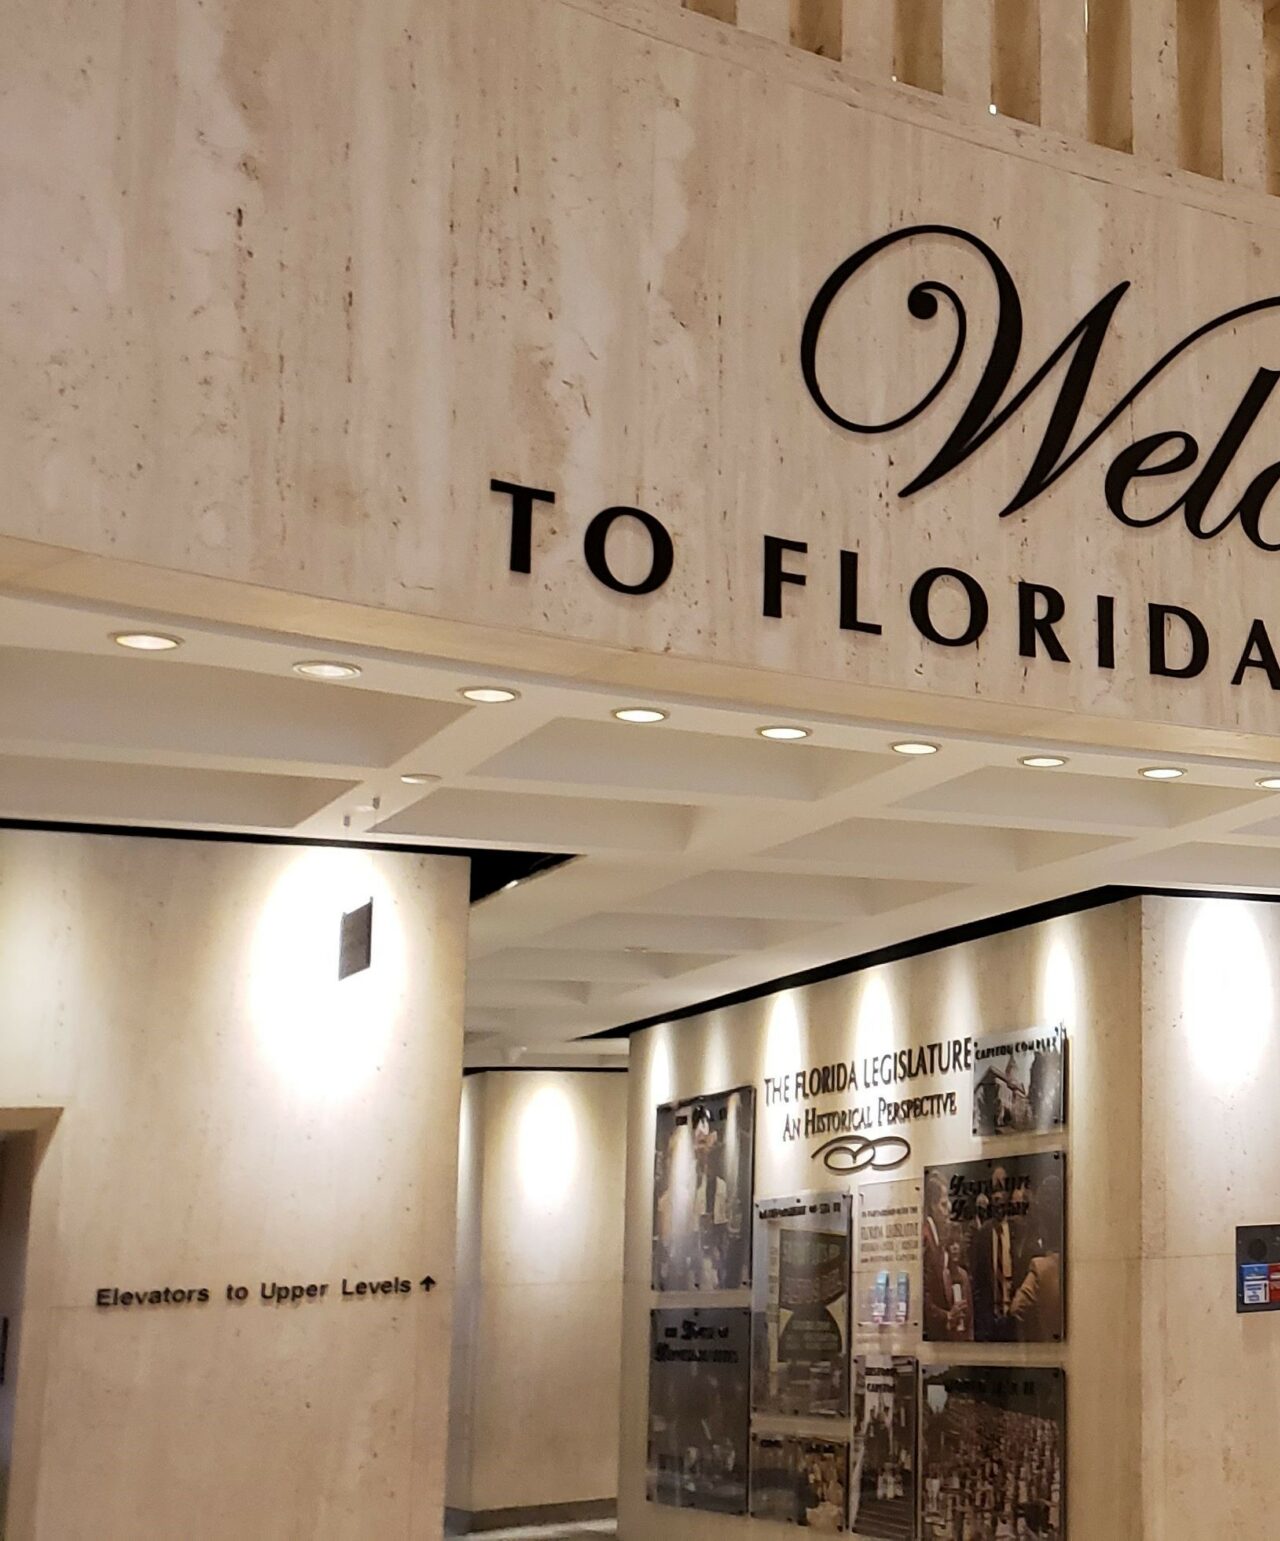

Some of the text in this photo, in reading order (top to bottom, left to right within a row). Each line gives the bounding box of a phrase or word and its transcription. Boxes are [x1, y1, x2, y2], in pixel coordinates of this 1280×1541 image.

[490, 478, 674, 596] TO
[764, 1075, 791, 1107] THE
[795, 1060, 858, 1099] FLORIDA
[95, 1276, 412, 1307] Elevators to Upper Levels
